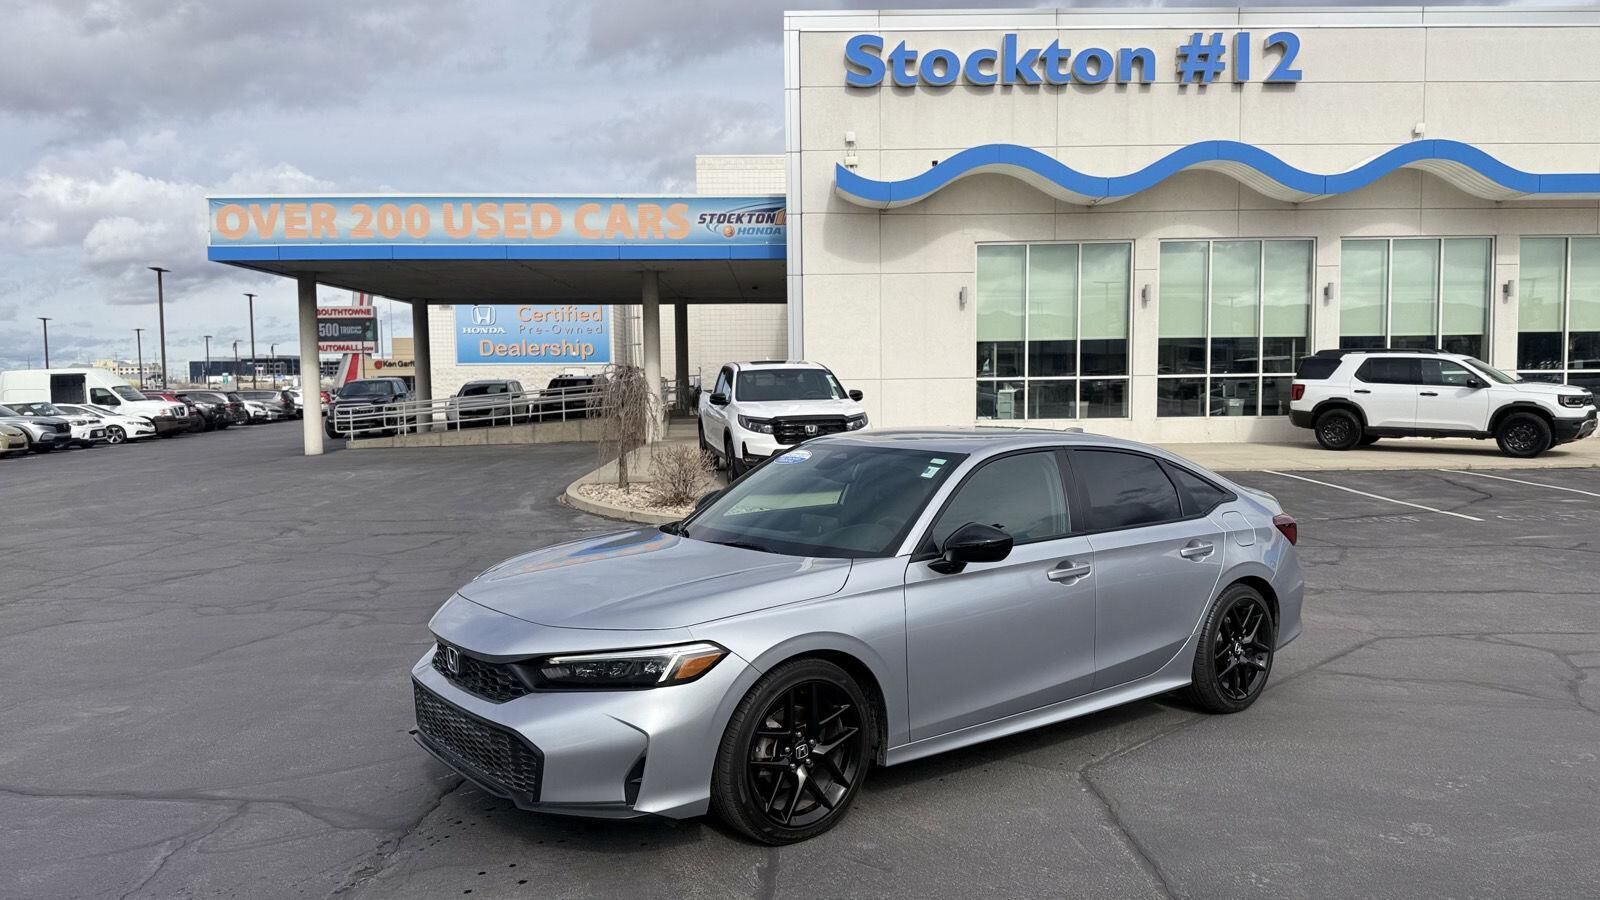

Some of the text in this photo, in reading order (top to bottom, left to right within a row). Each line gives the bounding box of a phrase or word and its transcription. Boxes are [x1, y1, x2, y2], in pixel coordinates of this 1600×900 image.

[845, 31, 1303, 88] Stockton #12
[215, 203, 690, 240] OVER 200 USED CARS
[698, 213, 776, 225] STOCKTON
[737, 227, 783, 236] HONDA
[519, 304, 603, 323] Certified
[318, 323, 340, 337] 500
[462, 327, 507, 335] HONDA
[519, 324, 603, 335] Pre-Owned
[479, 338, 594, 361] Dealership
[383, 360, 397, 368] Ken
